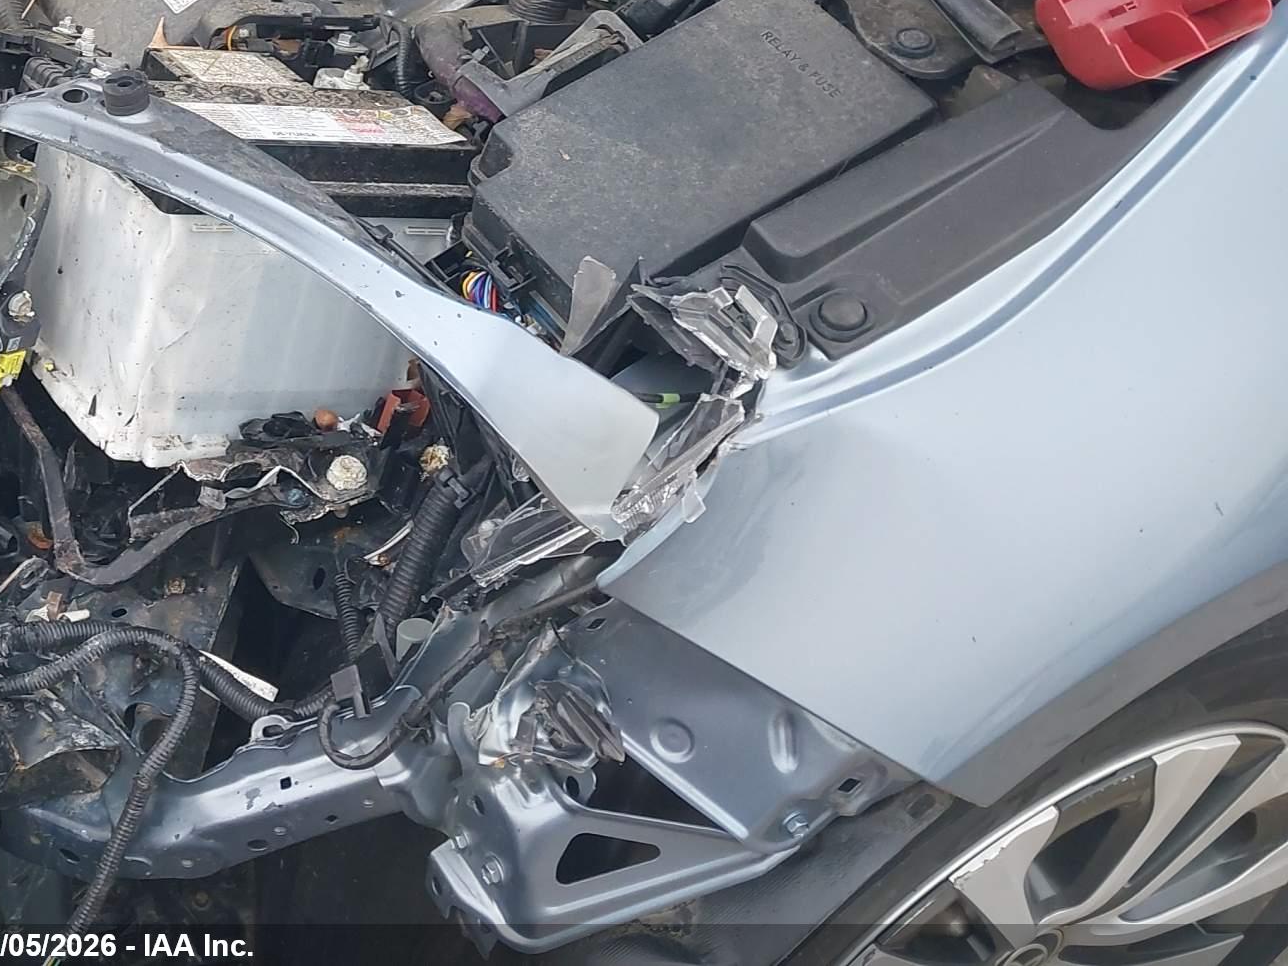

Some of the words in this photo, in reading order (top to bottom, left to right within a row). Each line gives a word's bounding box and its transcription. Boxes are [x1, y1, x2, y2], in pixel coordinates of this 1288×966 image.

[760, 30, 801, 62] RELAY
[797, 63, 809, 72] &
[808, 70, 841, 98] FUSE
